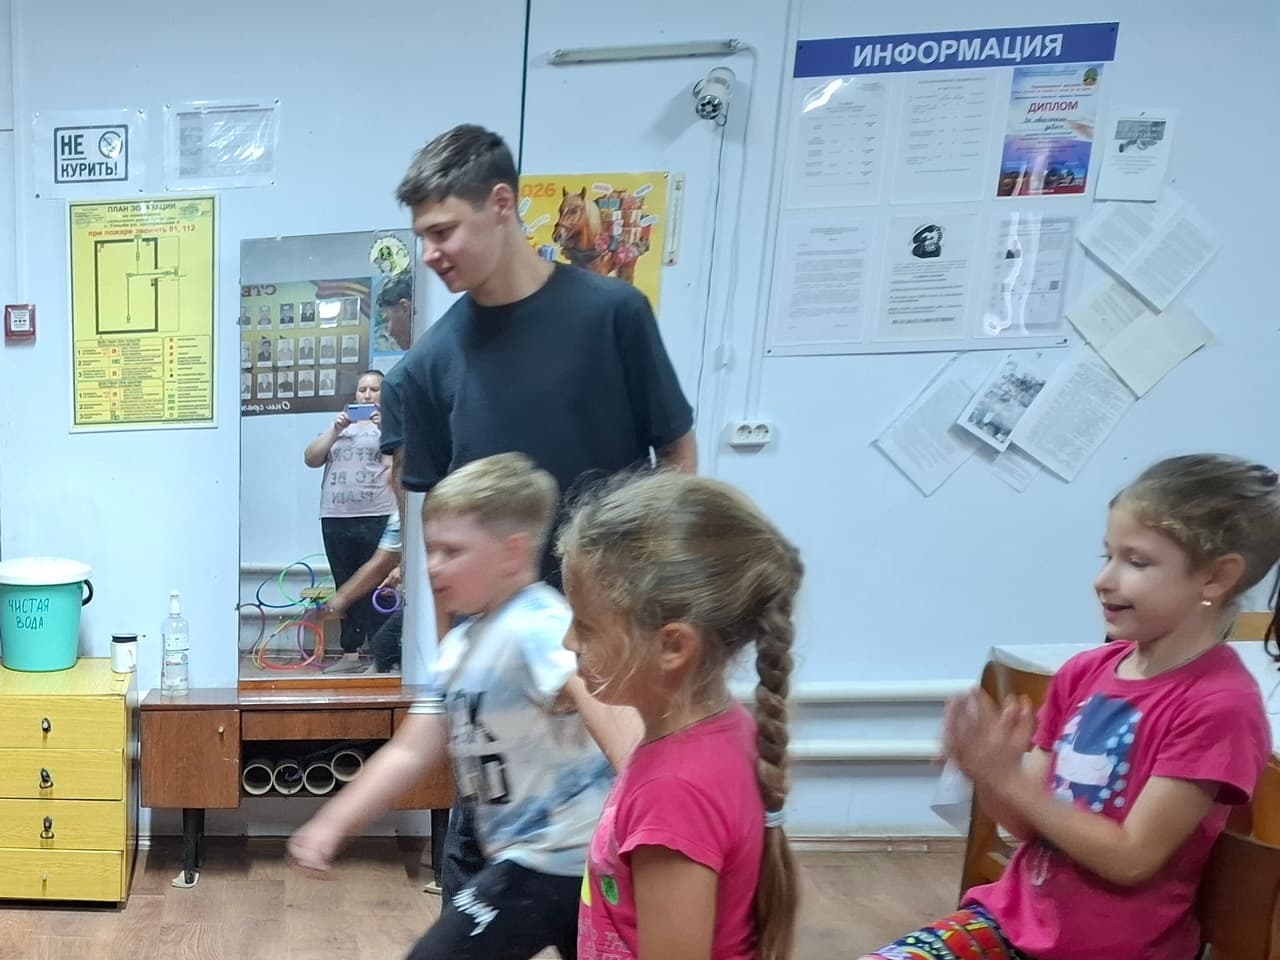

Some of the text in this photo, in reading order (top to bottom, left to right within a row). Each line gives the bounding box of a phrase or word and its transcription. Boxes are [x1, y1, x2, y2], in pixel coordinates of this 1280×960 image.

[853, 33, 1064, 68] ИНФОРМАЦИЯ
[1027, 100, 1078, 114] ДИПЛОМ
[60, 134, 85, 156] НЕ
[61, 161, 118, 178] КУРИТЬ!
[520, 183, 556, 198] 026
[107, 205, 129, 213] ПЛАН
[130, 202, 176, 213] ЭВКУАЦИИ
[88, 230, 102, 238] при
[104, 229, 133, 237] пожаре
[183, 224, 195, 232] 112
[8, 598, 50, 614] ЧИСТАЯ
[15, 615, 44, 630] ВОДА
